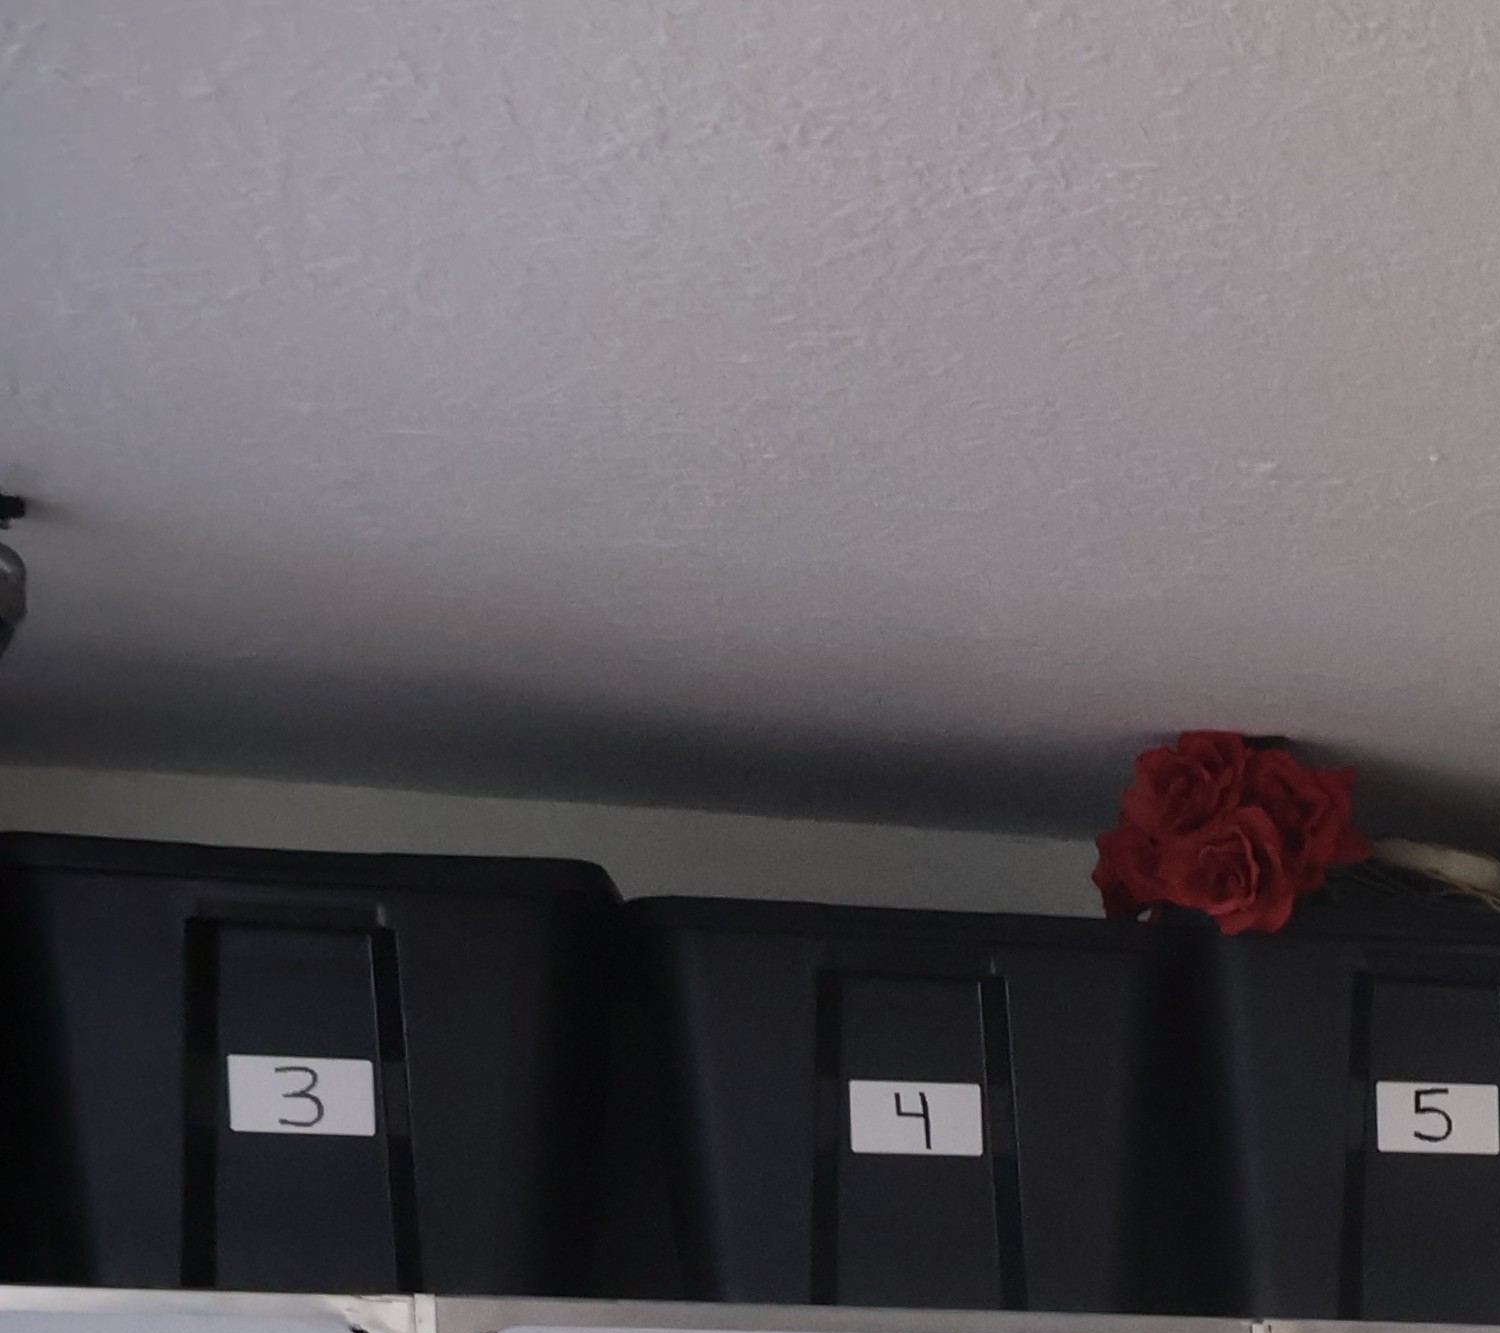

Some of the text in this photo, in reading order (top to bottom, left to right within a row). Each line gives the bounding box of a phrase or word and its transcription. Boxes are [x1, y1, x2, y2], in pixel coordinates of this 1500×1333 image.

[274, 1066, 324, 1128] 3
[894, 1091, 932, 1150] 4
[1413, 1088, 1453, 1143] 5
